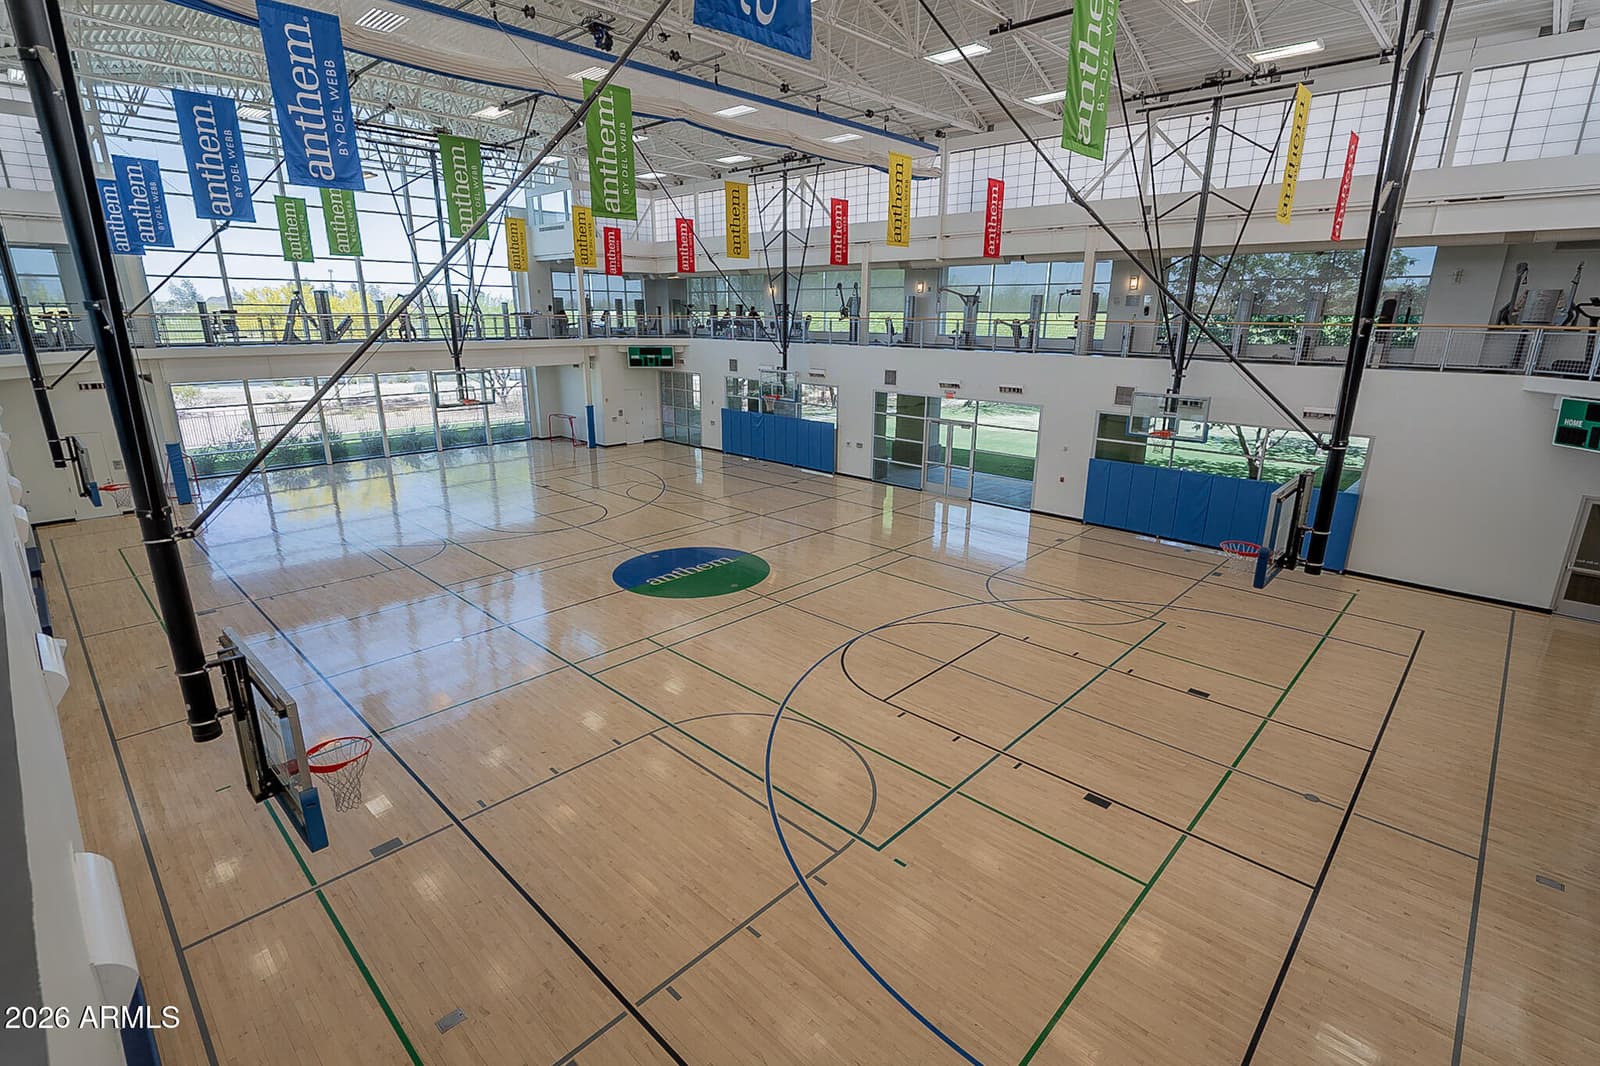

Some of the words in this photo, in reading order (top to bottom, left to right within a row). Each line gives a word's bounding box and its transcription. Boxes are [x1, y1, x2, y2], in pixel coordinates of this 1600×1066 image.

[324, 59, 341, 101] WEBB
[1077, 0, 1105, 145] anthe
[1096, 94, 1105, 111] BY
[332, 106, 348, 135] DEL
[223, 129, 236, 160] WEBB
[619, 122, 628, 153] WEBB
[337, 139, 349, 156] BY
[231, 163, 242, 182] DEL
[621, 158, 629, 178] DEL
[149, 181, 160, 203] WEBB
[234, 185, 243, 198] BY
[622, 182, 629, 195] BY
[154, 205, 163, 220] DEL
[1564, 418, 1584, 428] HOME
